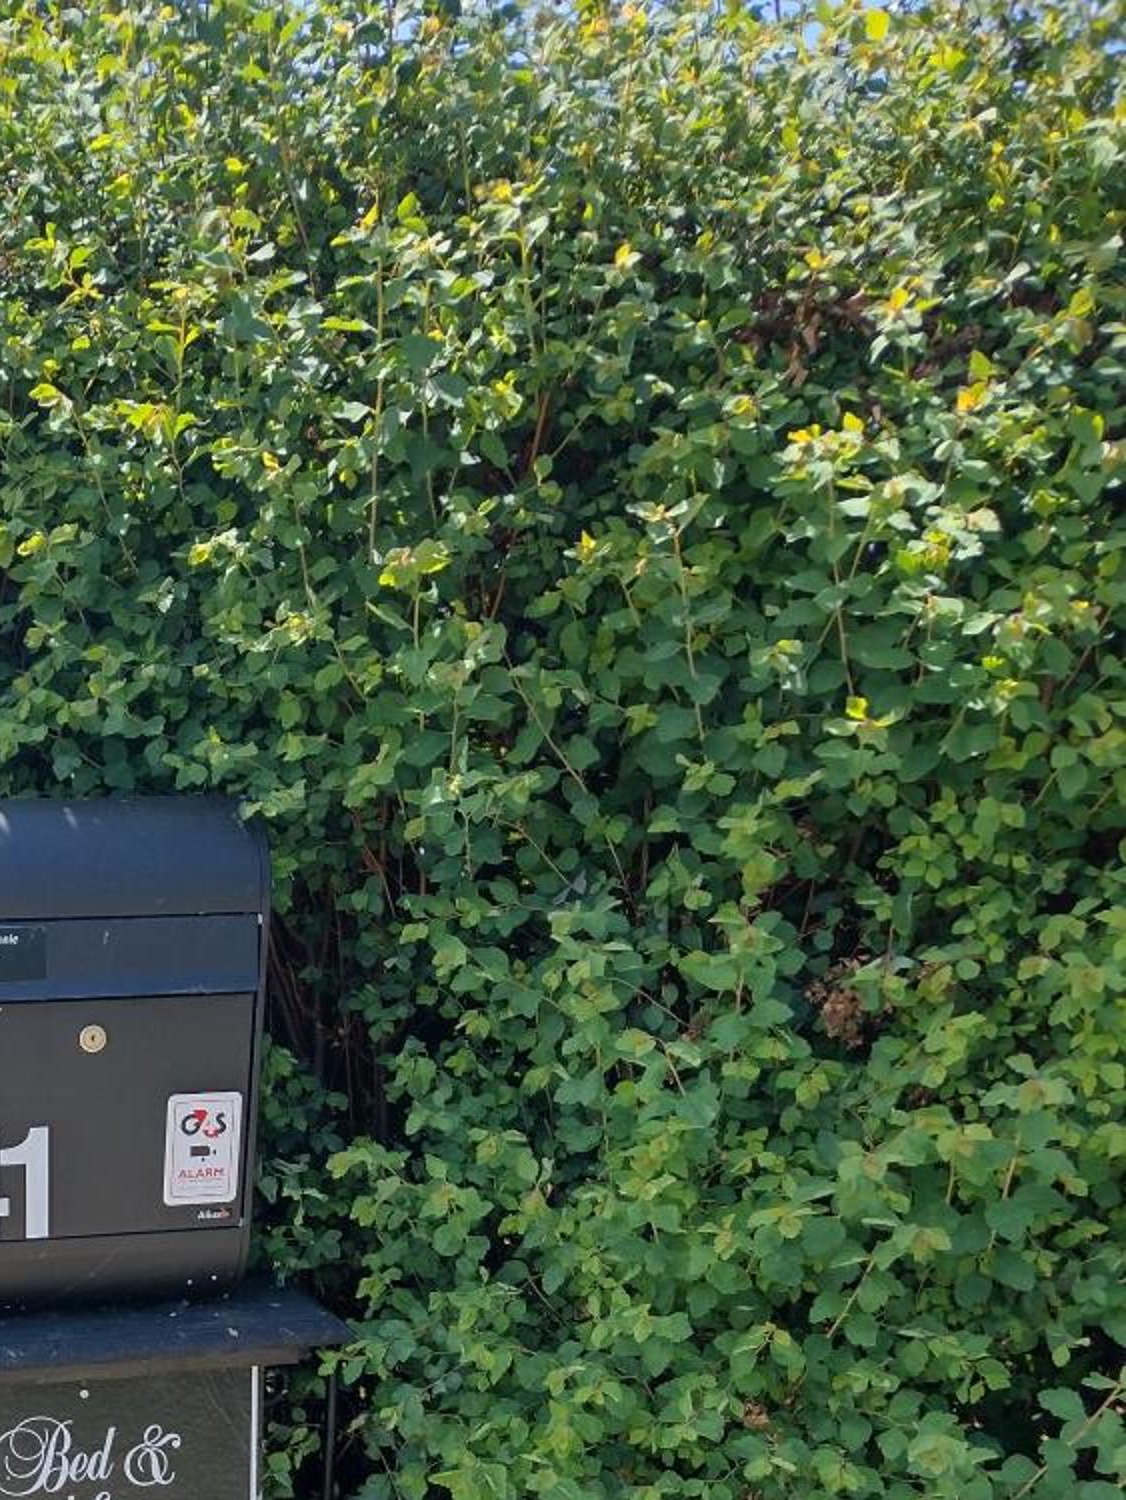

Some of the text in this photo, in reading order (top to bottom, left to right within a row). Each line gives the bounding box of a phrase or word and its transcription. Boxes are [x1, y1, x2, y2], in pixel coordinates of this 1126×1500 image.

[181, 1109, 227, 1137] G4S
[177, 1167, 225, 1179] ALARM
[124, 1424, 181, 1486] &
